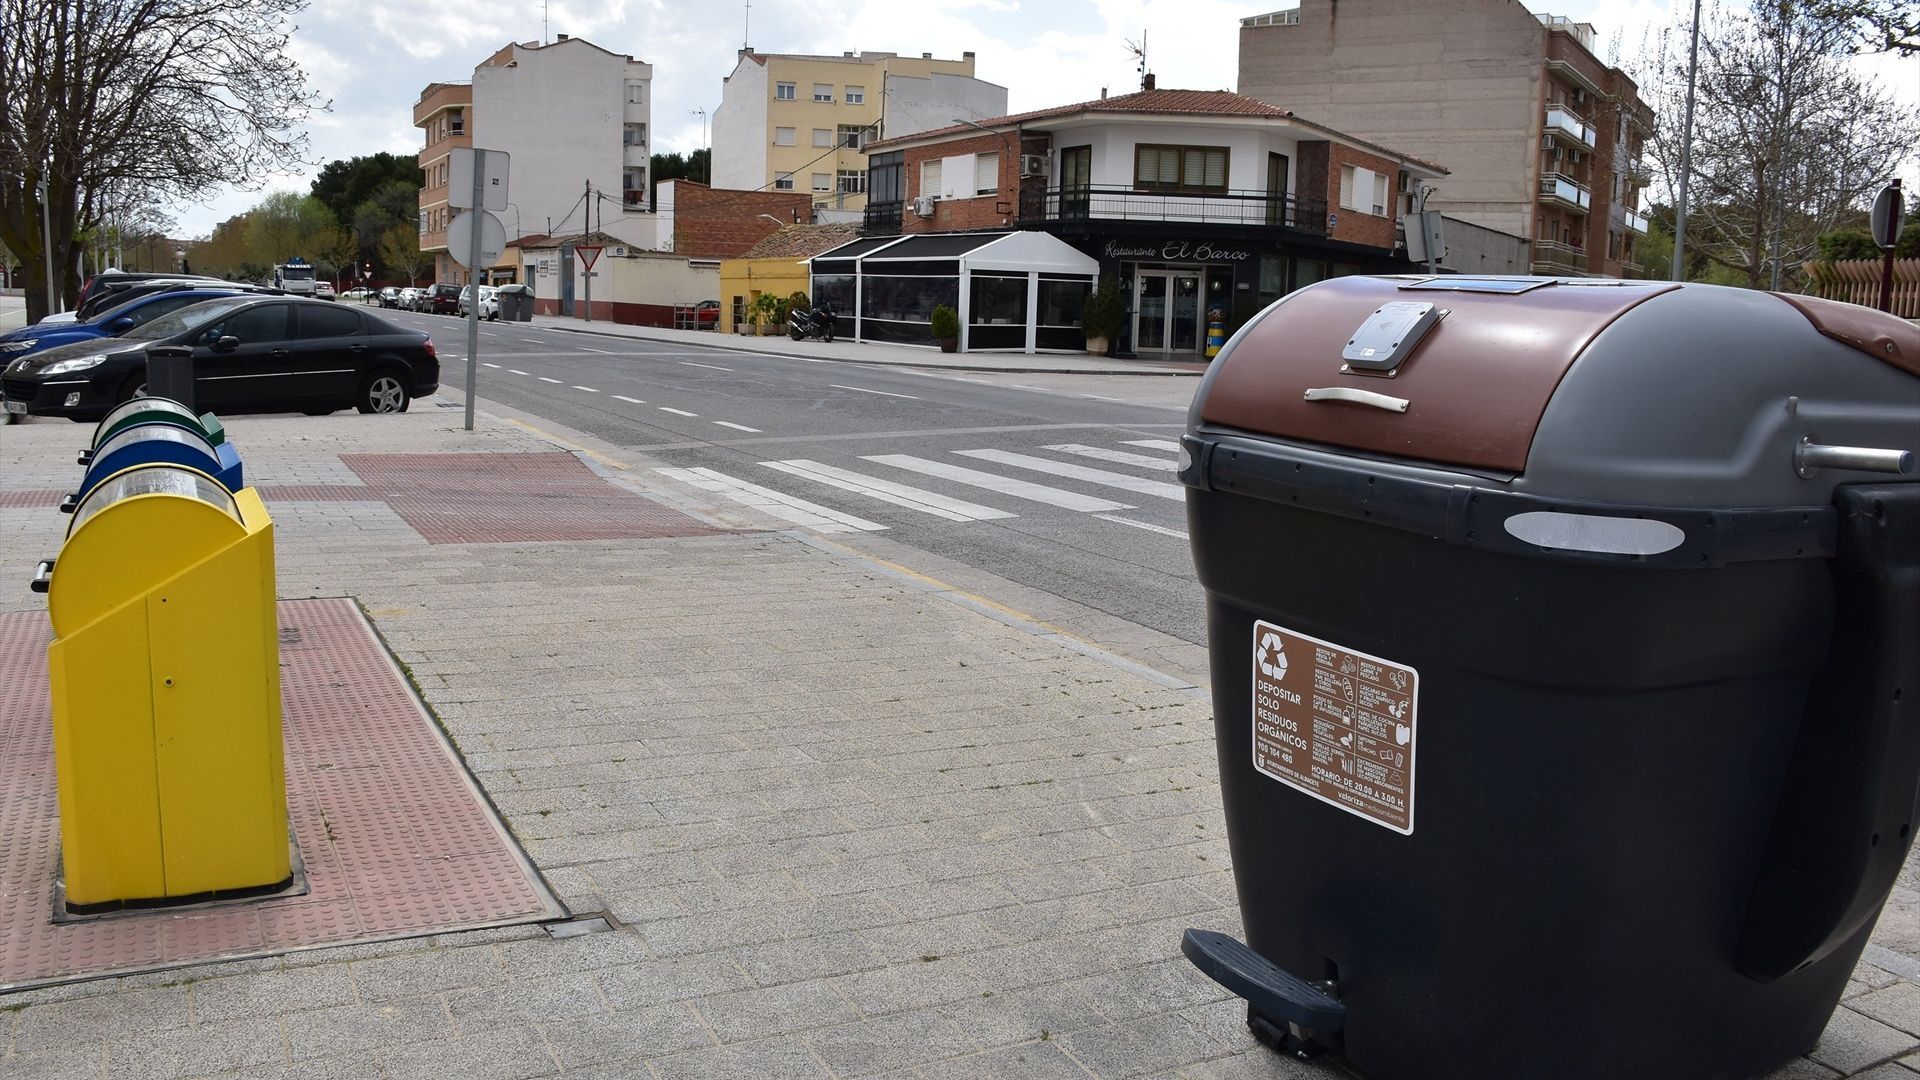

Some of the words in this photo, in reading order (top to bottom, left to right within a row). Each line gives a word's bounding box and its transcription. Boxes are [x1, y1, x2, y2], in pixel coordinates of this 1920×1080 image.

[1104, 239, 1156, 258] Restaurante
[1162, 240, 1191, 259] El
[1193, 241, 1250, 260] Barco
[1258, 694, 1279, 711] SOLO
[1259, 680, 1301, 704] DEPOSITAR
[1258, 708, 1297, 732] RESIDUOS
[1258, 721, 1307, 750] ORGÁNICOS
[1258, 741, 1268, 753] 900
[1270, 747, 1279, 758] 104
[1300, 774, 1319, 787] ALBACETE
[1312, 765, 1343, 783] HORARIO:
[1344, 778, 1353, 787] DE
[1355, 782, 1372, 795] 20.00
[1381, 792, 1395, 804] 3.00
[1398, 798, 1405, 807] H.
